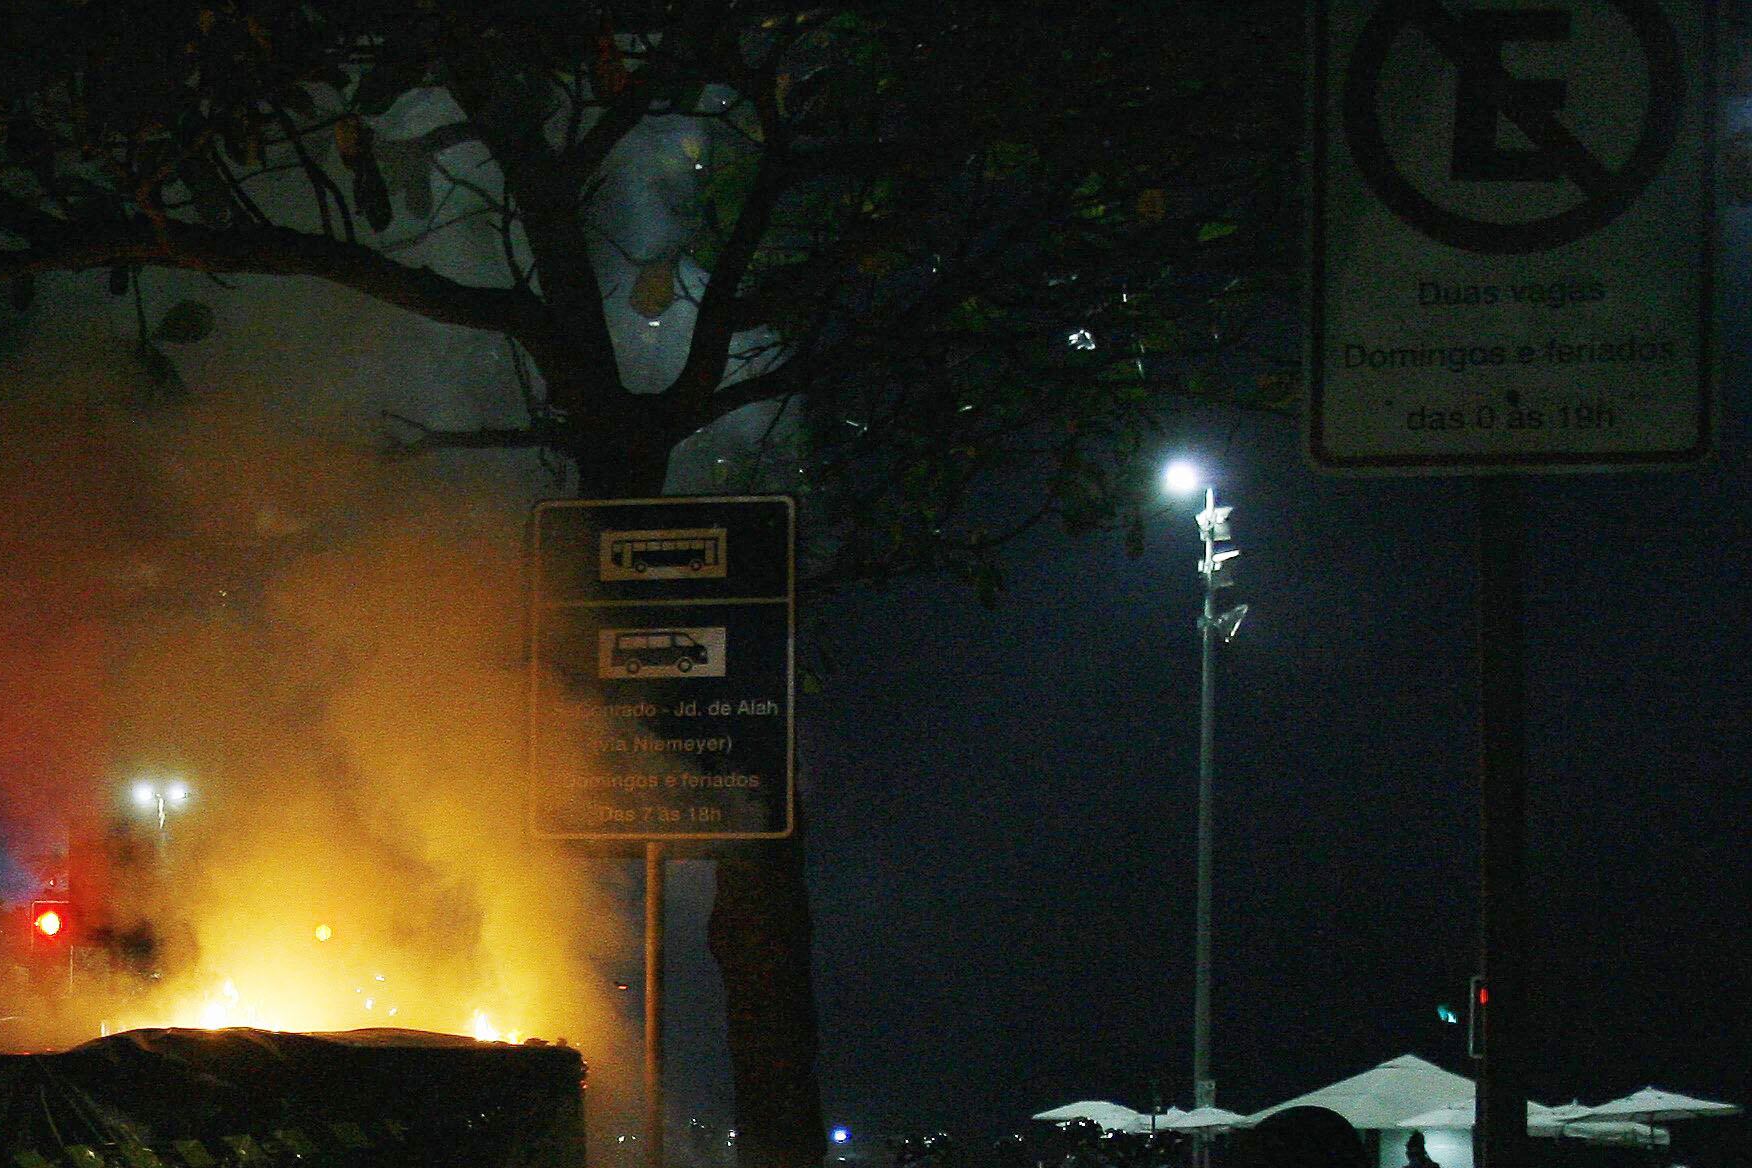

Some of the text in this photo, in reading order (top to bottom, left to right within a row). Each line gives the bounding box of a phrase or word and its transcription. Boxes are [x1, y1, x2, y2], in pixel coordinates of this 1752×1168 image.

[1417, 280, 1606, 310] Duas vagas
[1344, 335, 1676, 373] Domingos e feriados
[1406, 405, 1466, 431] das
[672, 701, 702, 718] Jd.
[707, 701, 732, 717] de
[736, 698, 779, 717] Alah
[664, 775, 677, 789] e
[682, 771, 760, 789] feriados
